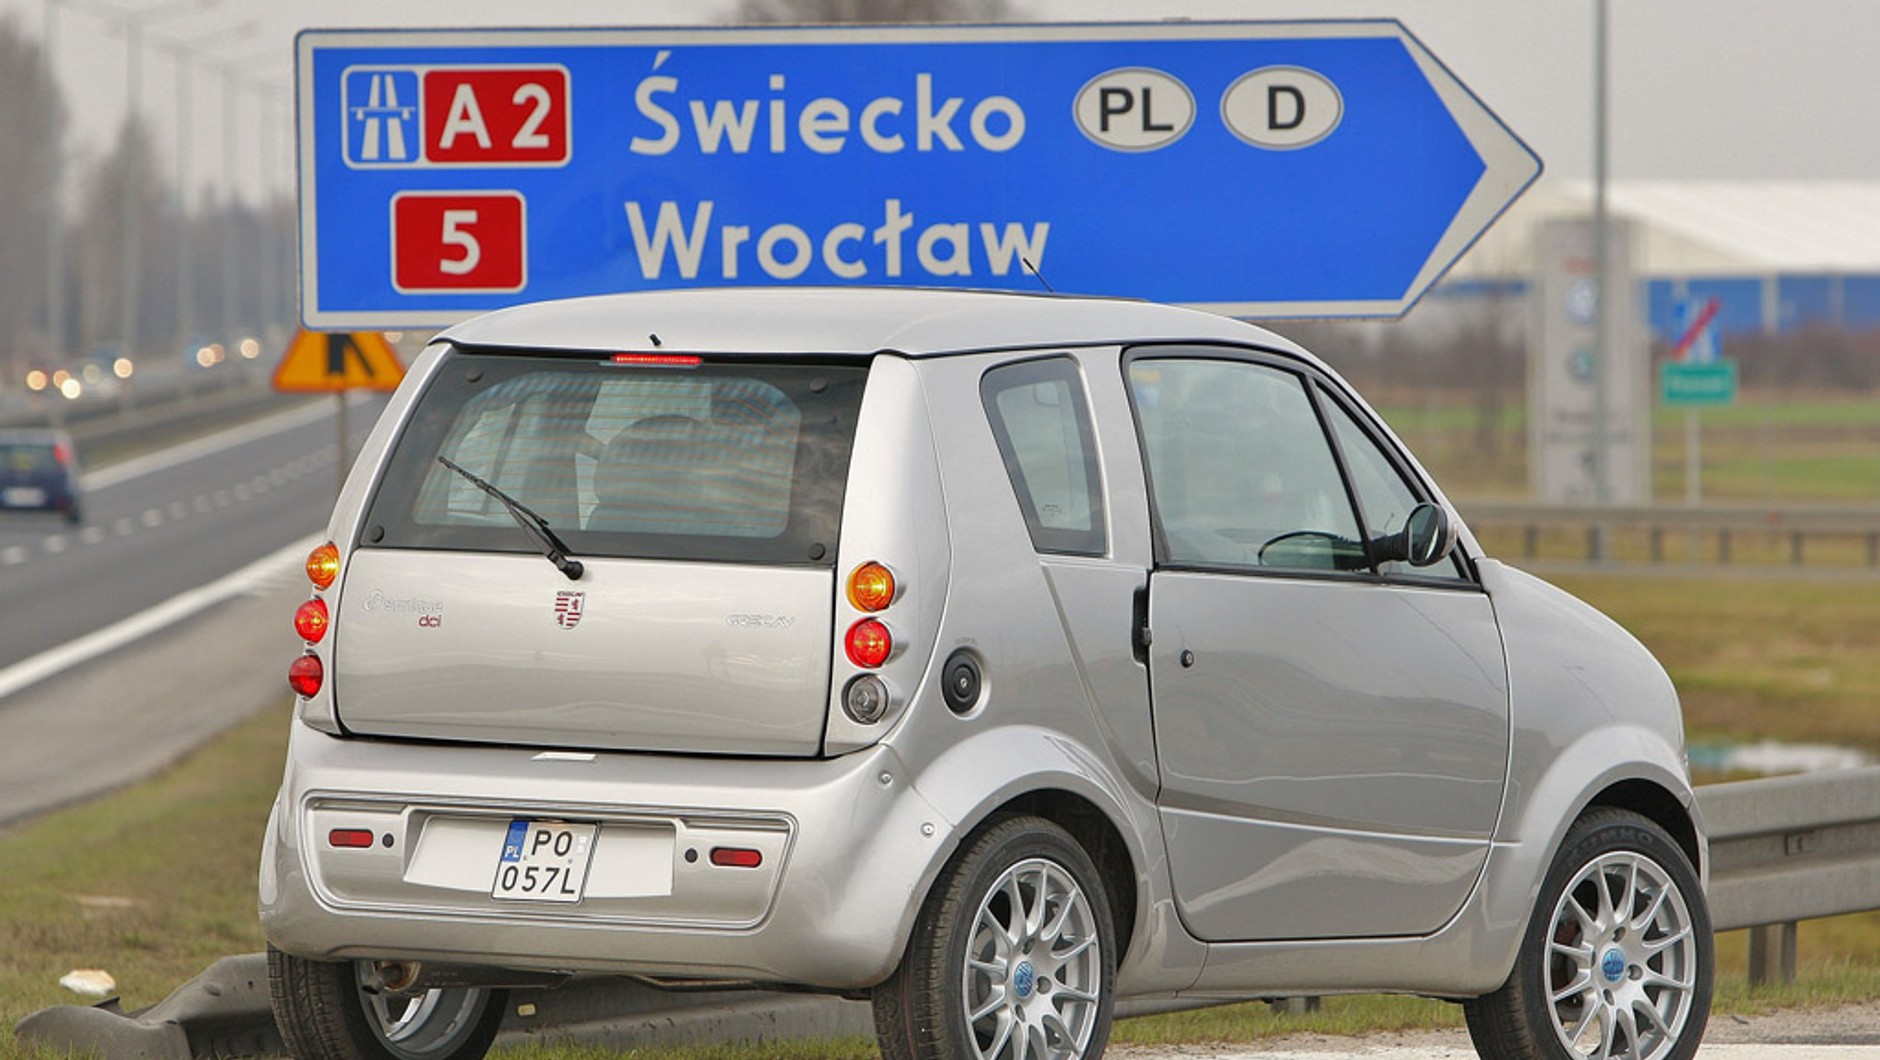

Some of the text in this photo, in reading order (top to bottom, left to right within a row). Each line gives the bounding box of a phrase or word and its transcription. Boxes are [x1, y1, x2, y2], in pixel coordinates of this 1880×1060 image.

[630, 51, 1026, 155] Świecko
[1099, 87, 1175, 134] PL
[1267, 85, 1306, 131] D
[440, 210, 481, 275] 5
[625, 199, 1050, 279] Wrocław
[504, 845, 520, 859] PL
[531, 829, 573, 857] PO
[501, 865, 576, 895] 057L
